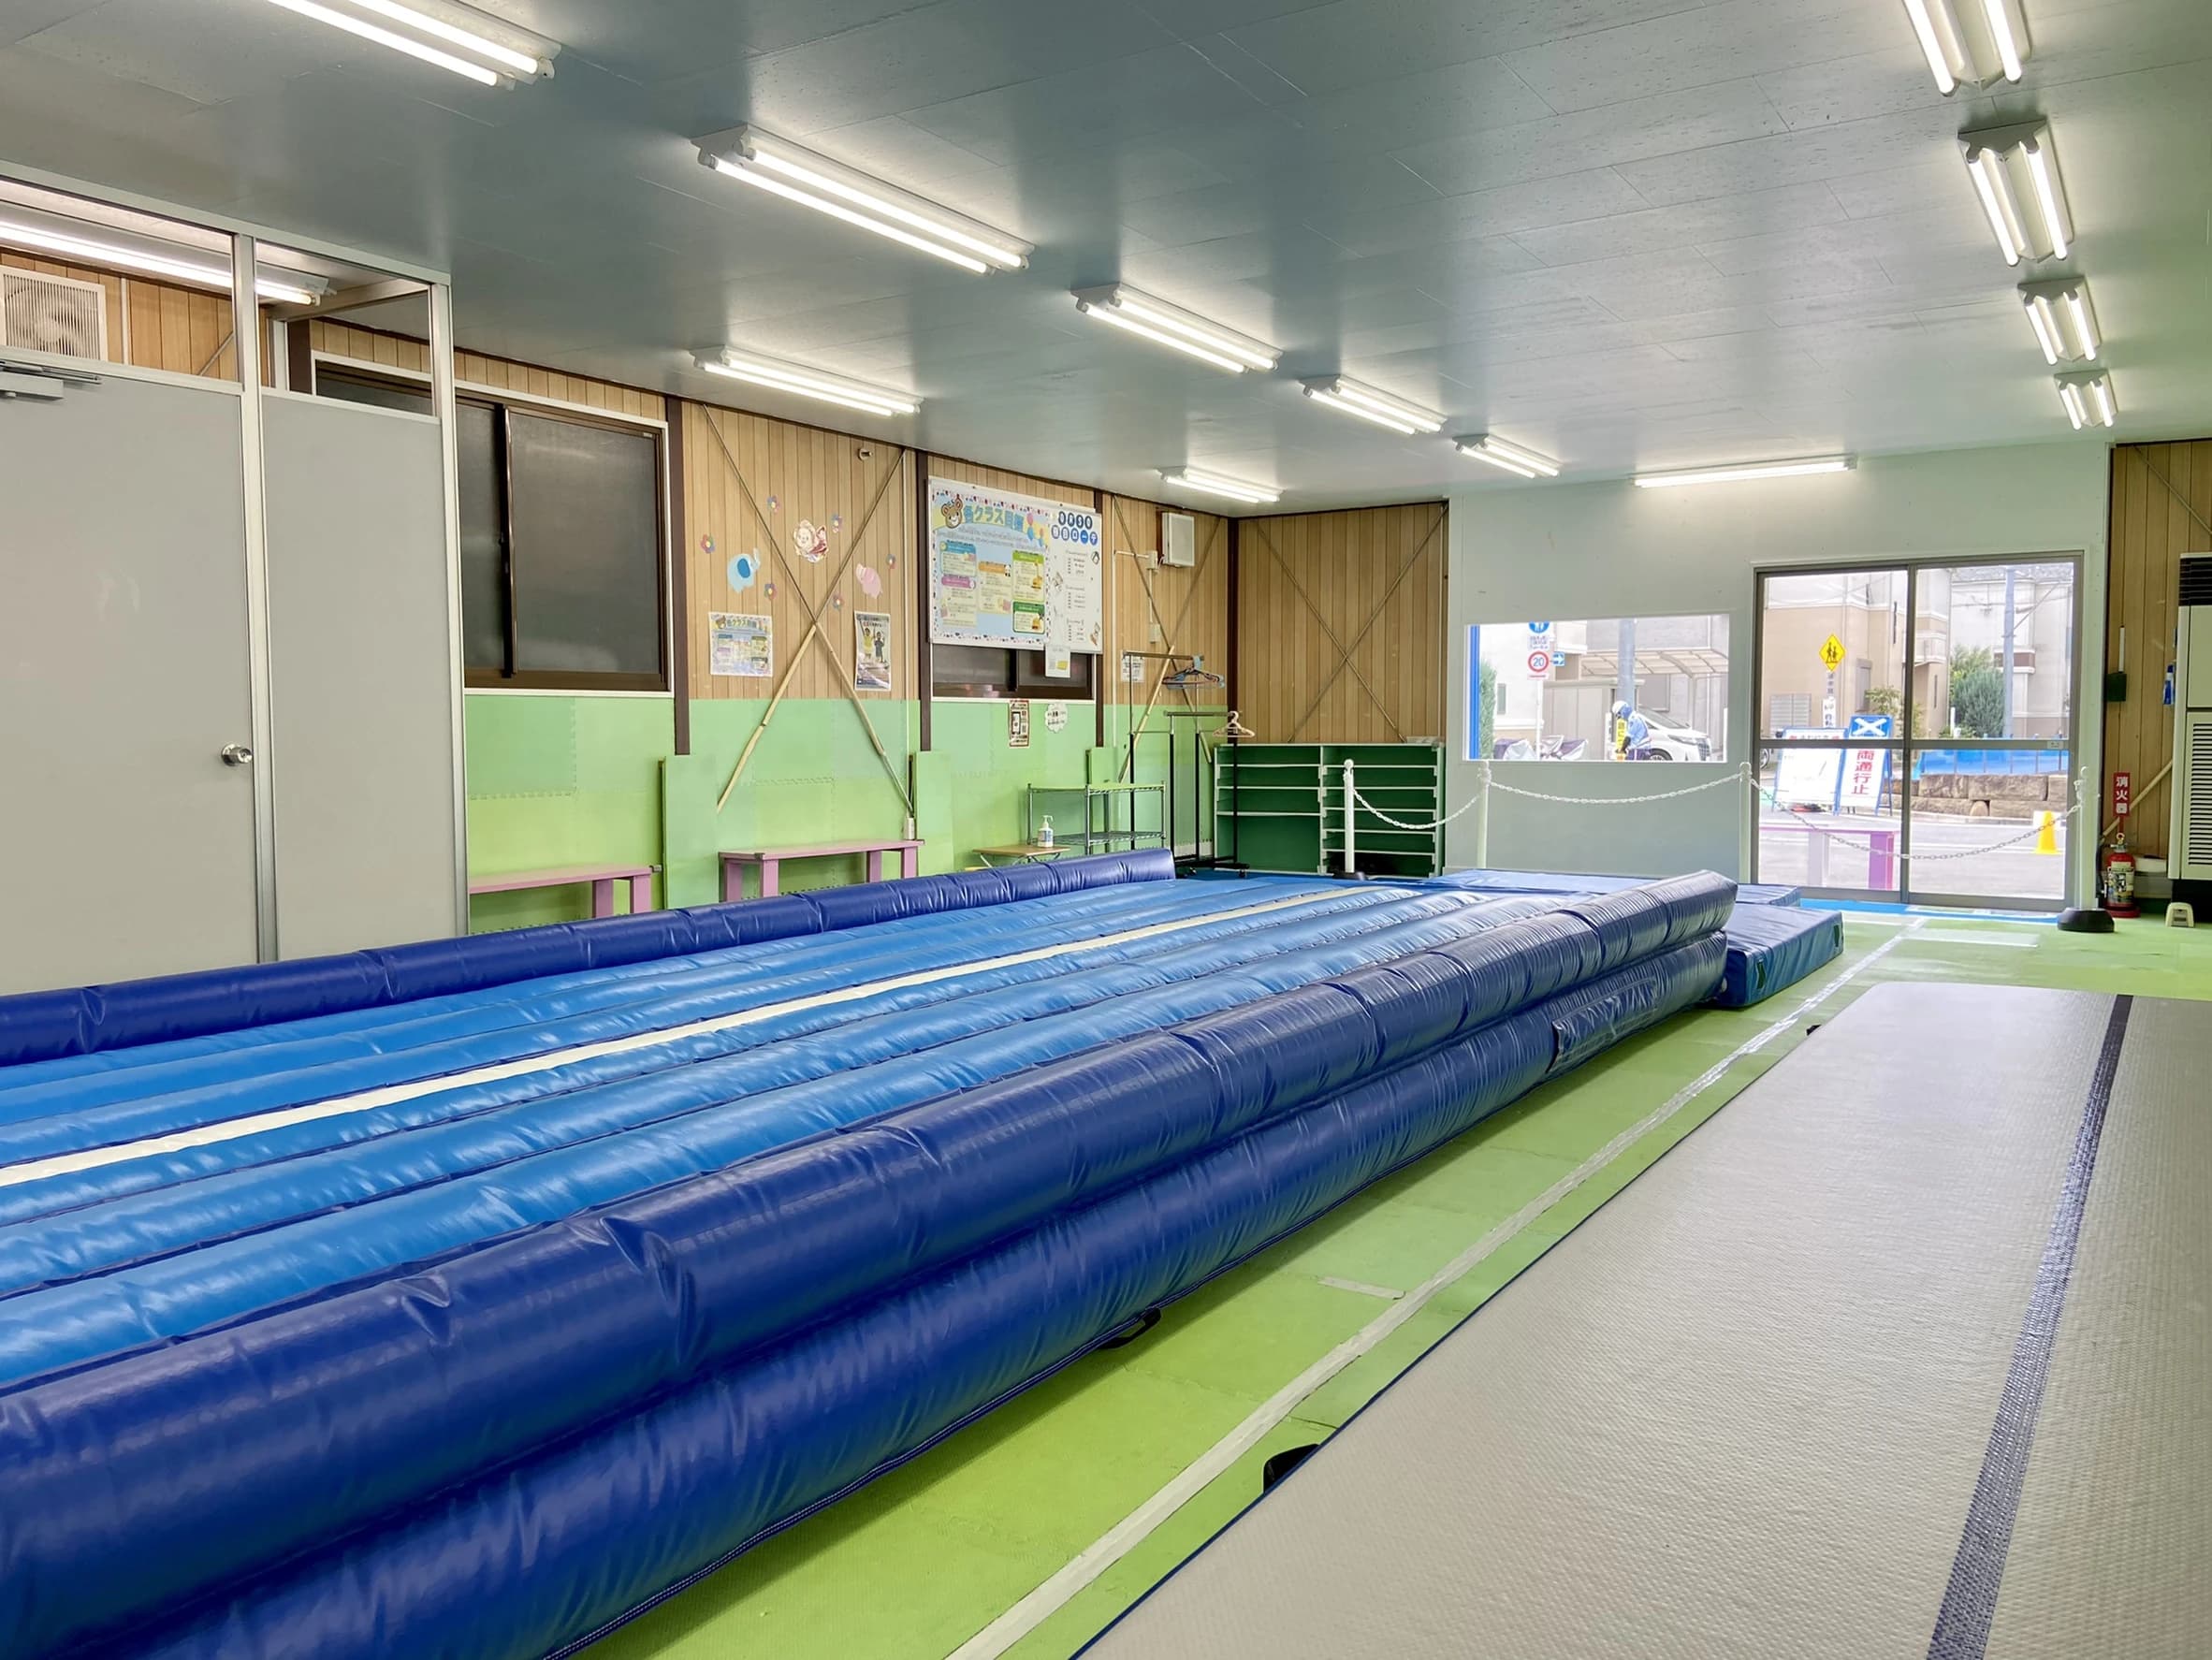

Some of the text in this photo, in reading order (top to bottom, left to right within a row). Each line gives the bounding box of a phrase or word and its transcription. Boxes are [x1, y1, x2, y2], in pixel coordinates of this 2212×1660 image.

[1533, 657, 1544, 666] 20
[1852, 750, 1874, 794] 両通行止
